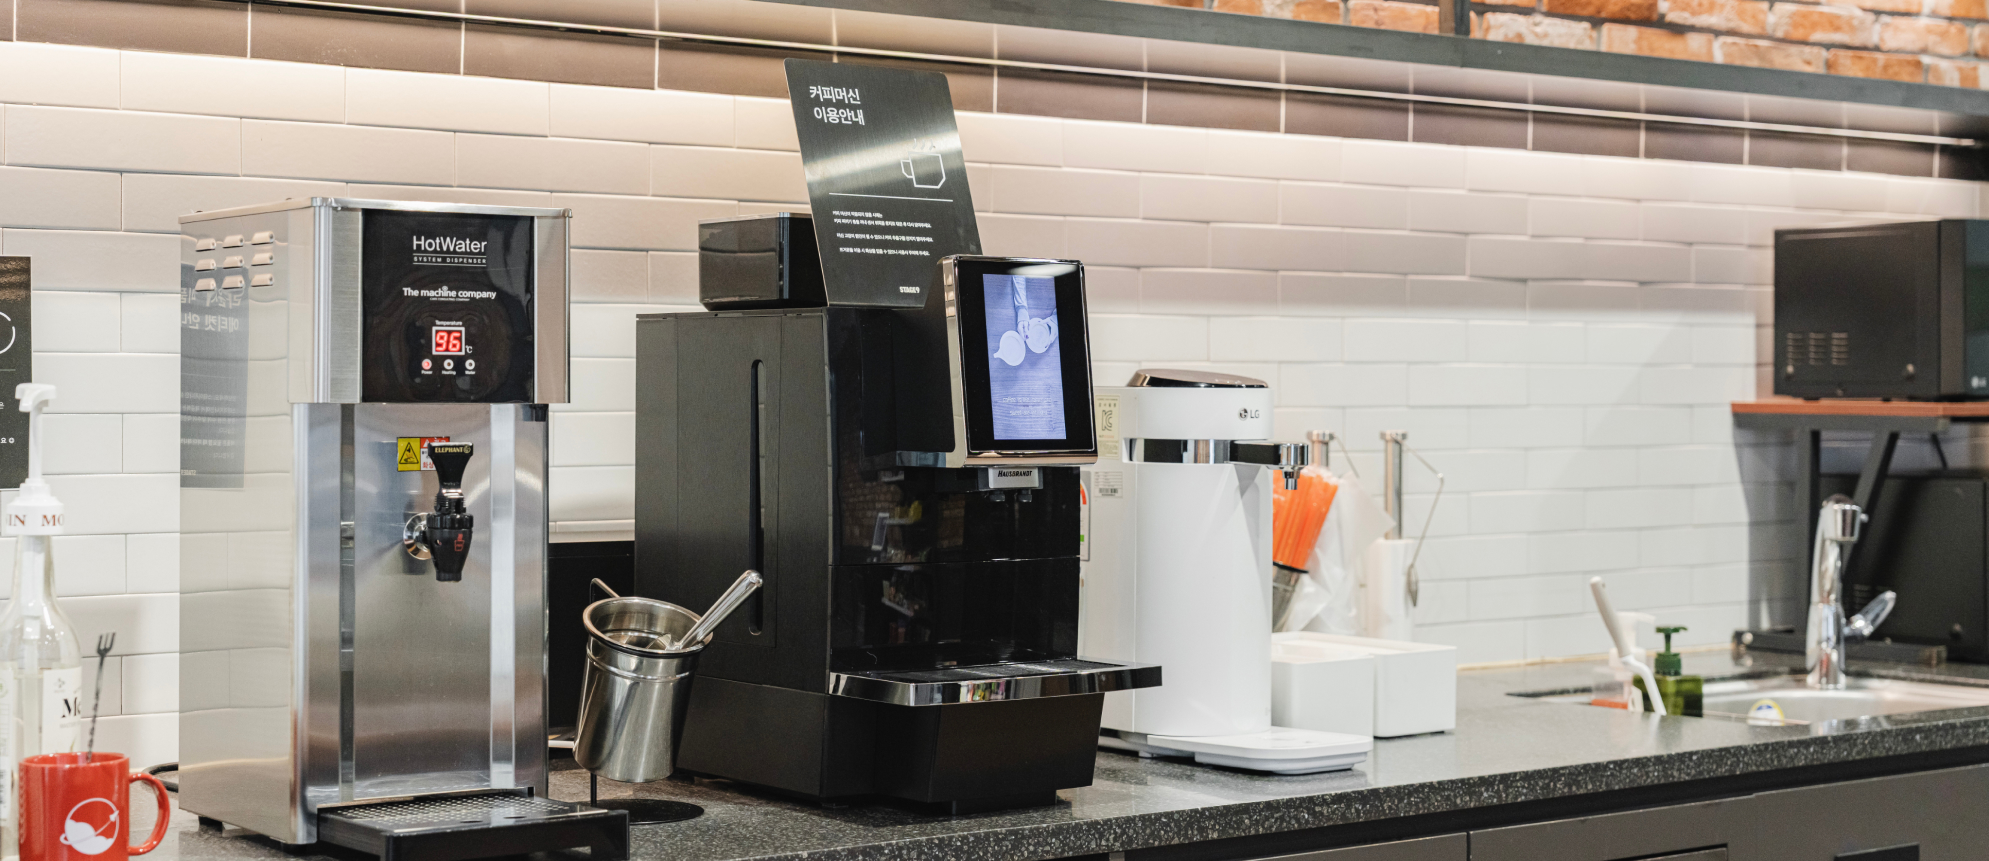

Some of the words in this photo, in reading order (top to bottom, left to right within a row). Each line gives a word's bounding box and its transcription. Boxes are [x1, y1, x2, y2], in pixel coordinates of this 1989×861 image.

[809, 85, 861, 104] 커피머신
[813, 106, 866, 126] 이용안내
[413, 235, 487, 253] HotWater
[402, 287, 420, 297] The
[420, 286, 457, 298] machine
[458, 290, 497, 300] company
[435, 330, 461, 352] 96
[1250, 410, 1260, 418] LG
[6, 514, 27, 526] IN
